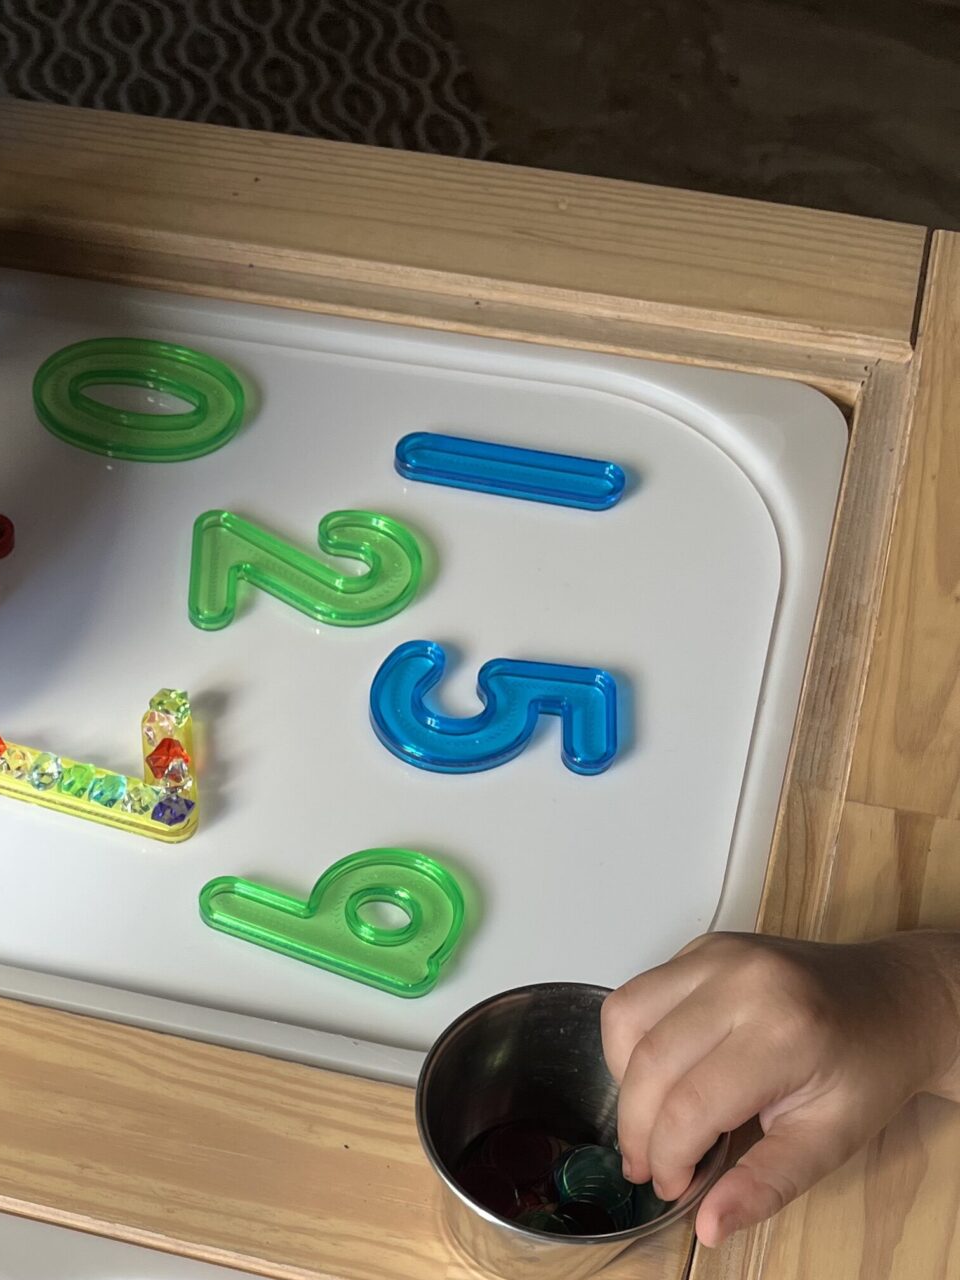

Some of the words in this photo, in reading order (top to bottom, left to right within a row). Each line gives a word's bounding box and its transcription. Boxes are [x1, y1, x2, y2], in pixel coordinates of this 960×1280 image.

[34, 338, 245, 462] 0
[188, 509, 423, 631] 2
[369, 640, 617, 775] 5
[199, 847, 466, 999] 9
